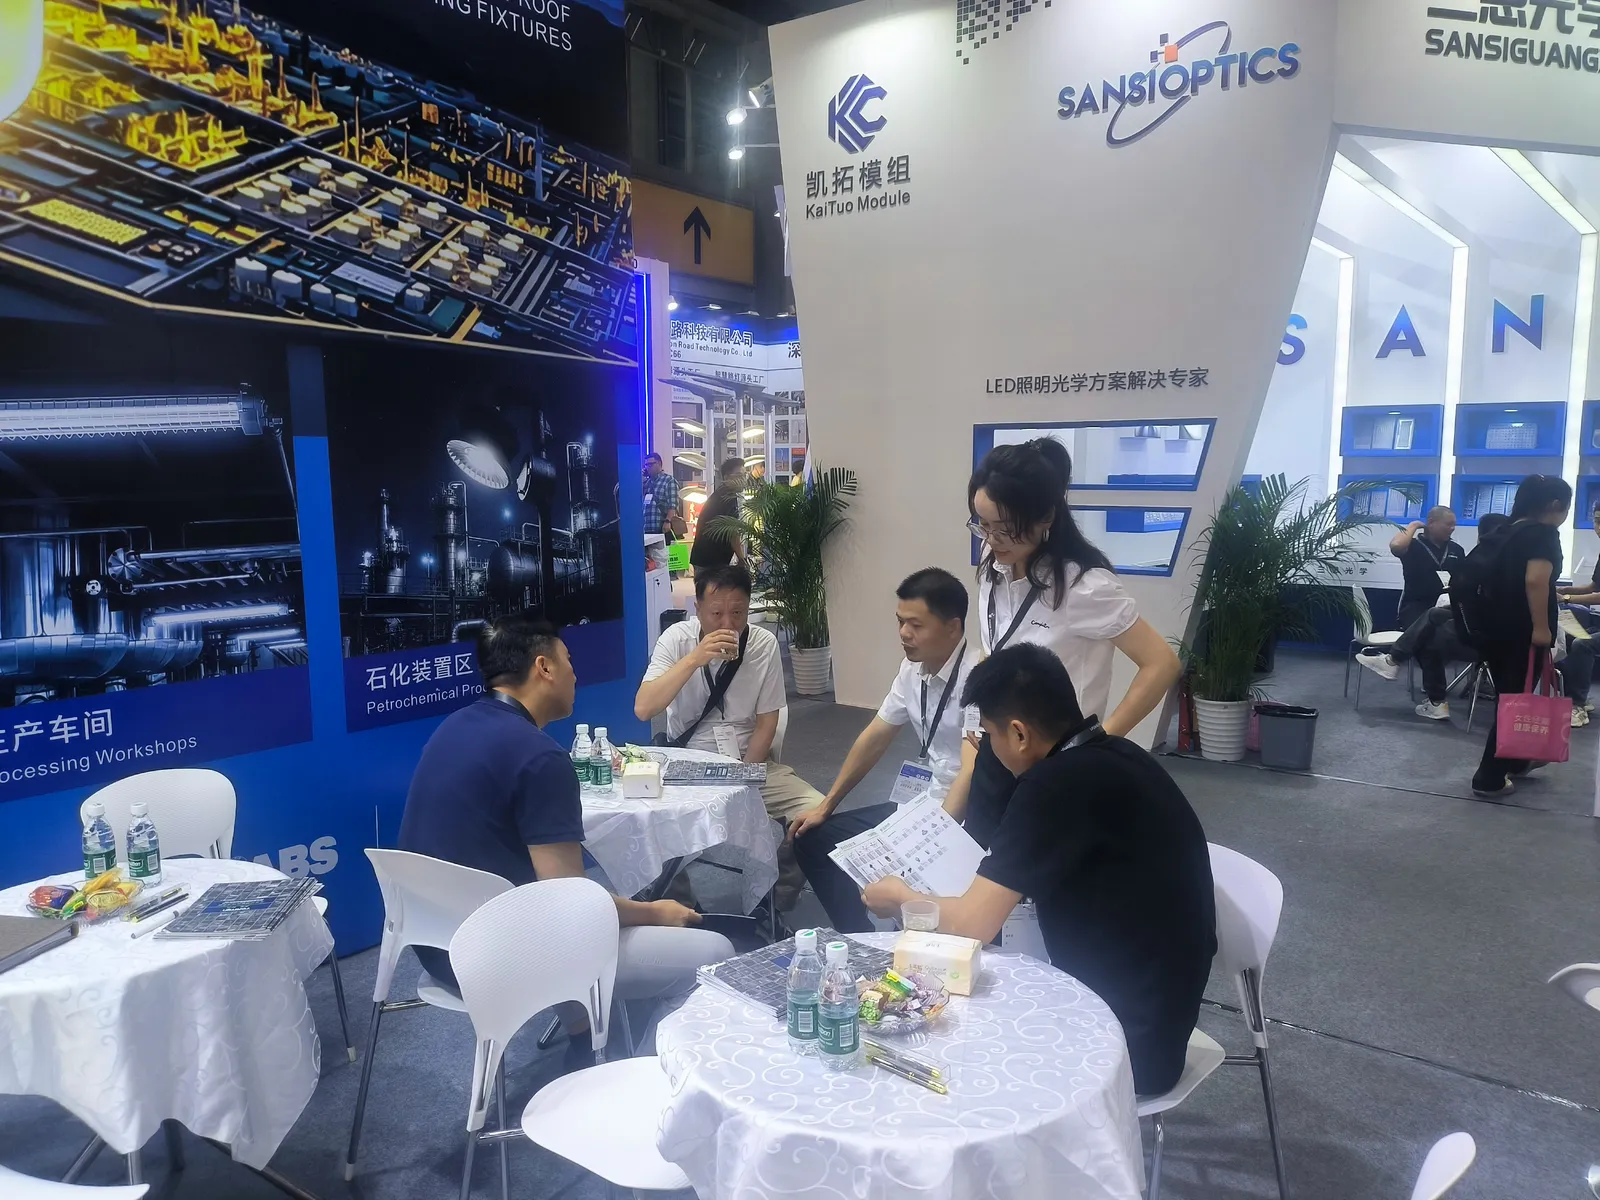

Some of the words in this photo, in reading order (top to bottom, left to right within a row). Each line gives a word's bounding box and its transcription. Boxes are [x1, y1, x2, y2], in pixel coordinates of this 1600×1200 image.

[477, 0, 572, 51] FIXTURES
[1425, 28, 1600, 73] SANSIGUANG
[1057, 43, 1301, 119] SANSIOPTICS
[806, 155, 911, 199] 凯拓模组
[806, 201, 854, 219] KaiTuo
[857, 190, 911, 213] Module
[671, 320, 753, 348] 路科技有限公司
[678, 341, 695, 350] Road
[695, 343, 730, 355] Technology
[986, 367, 1209, 394] LED照明光学方案解决专家
[366, 653, 474, 691] 石化装置区
[366, 686, 459, 714] Petrochemical
[96, 736, 197, 764] Workshops
